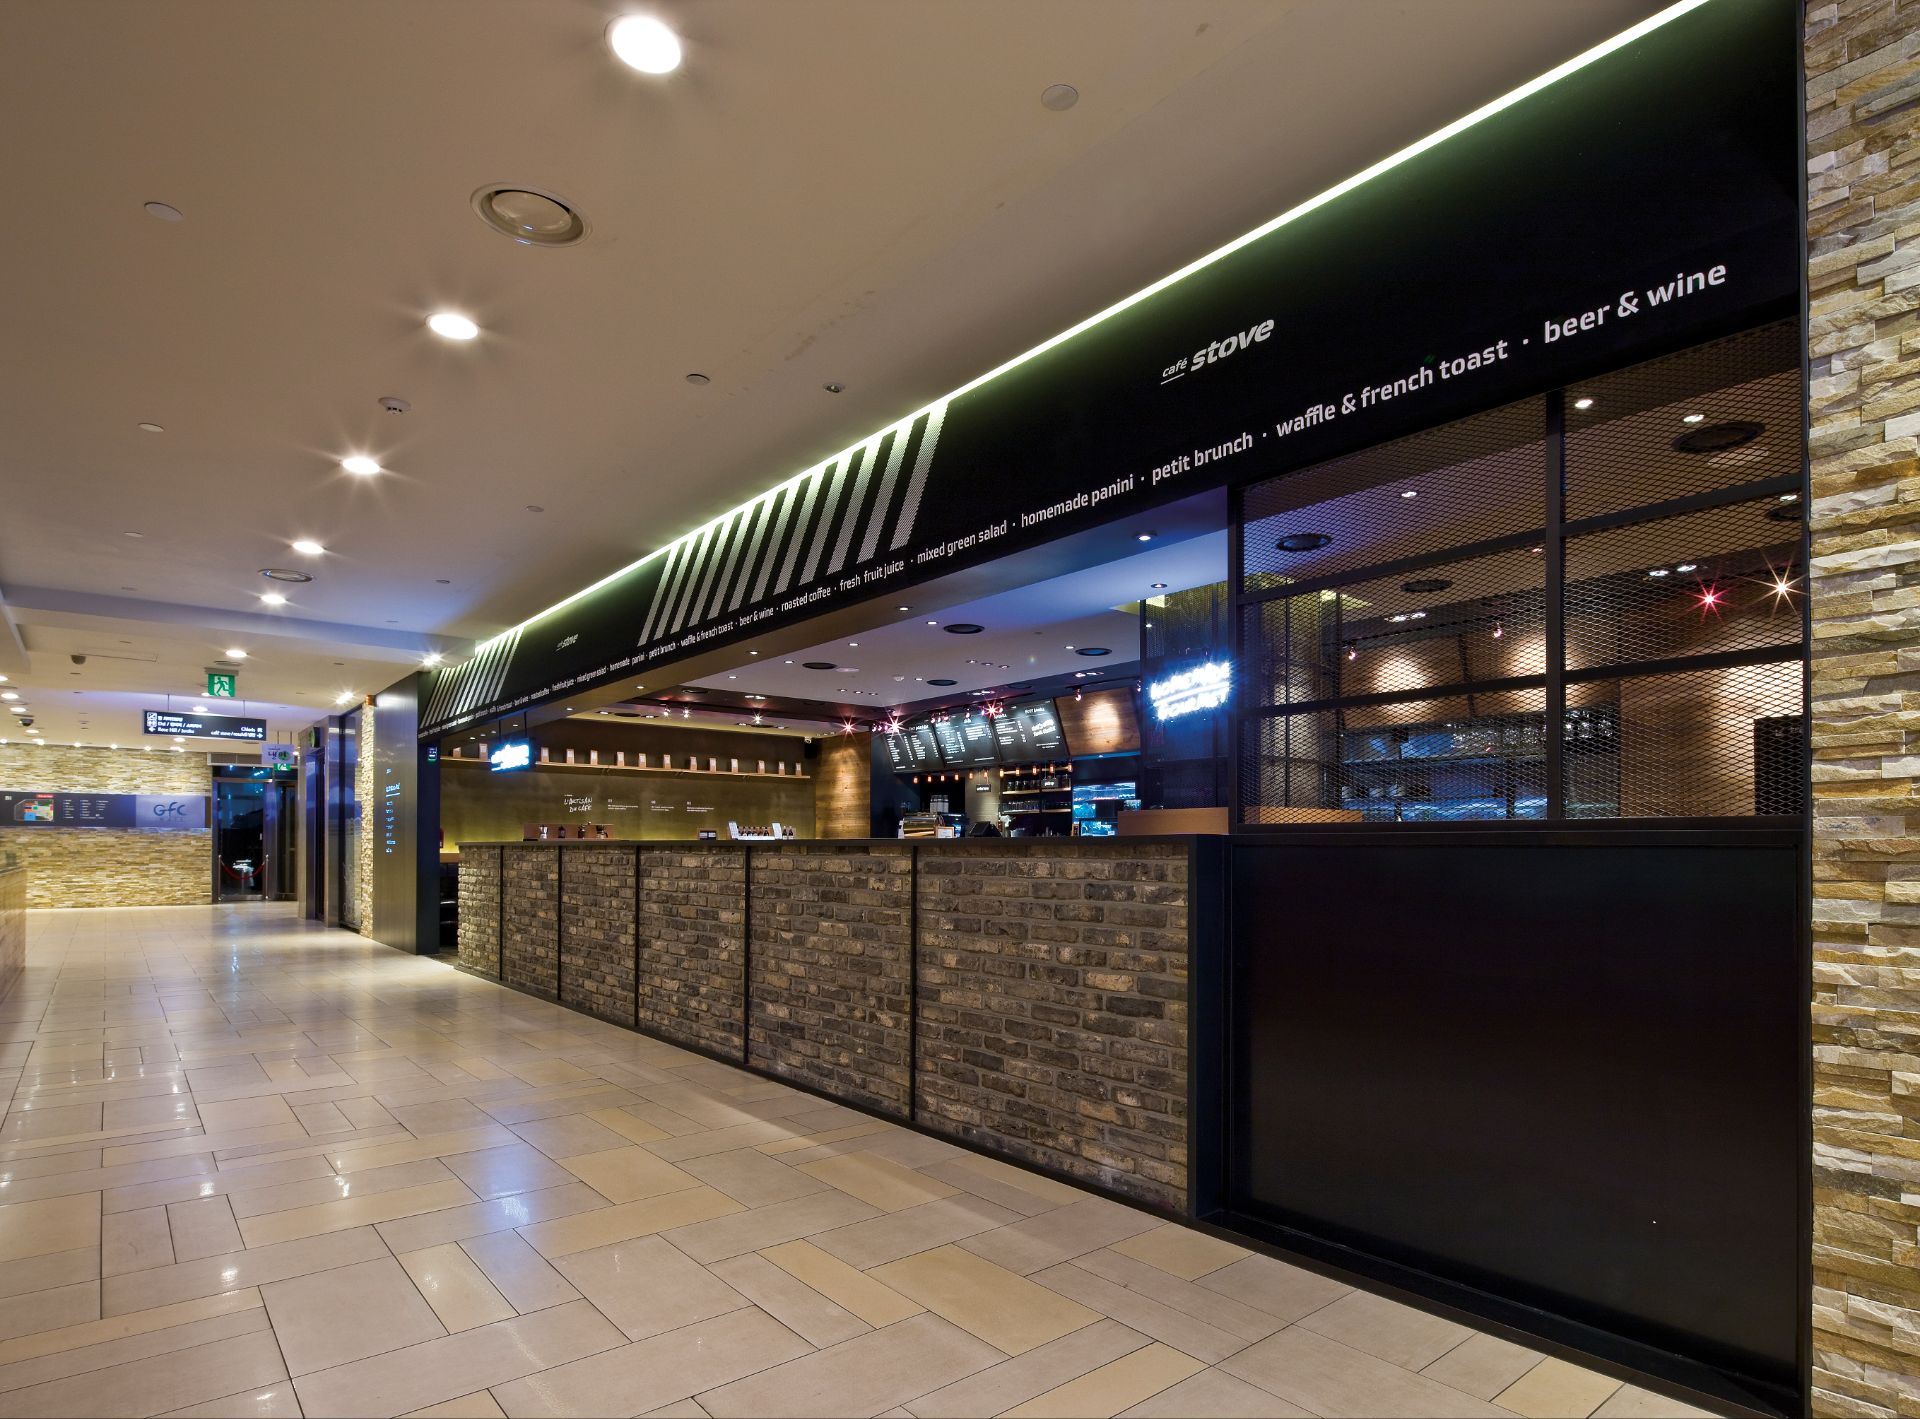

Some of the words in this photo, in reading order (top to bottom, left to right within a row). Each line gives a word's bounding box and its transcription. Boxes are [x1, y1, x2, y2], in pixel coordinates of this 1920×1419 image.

[718, 622, 733, 634] toast
[740, 615, 752, 626] beer
[759, 608, 773, 619] wine
[781, 592, 807, 611] roasted
[809, 587, 830, 602] coffee
[840, 575, 860, 591] fresh
[864, 567, 883, 582] fruit
[882, 561, 904, 578] juice
[918, 542, 944, 563] mixed
[948, 535, 975, 556] green
[979, 520, 1006, 542] salad
[1022, 493, 1088, 527] homemade
[1092, 474, 1133, 506] panini
[1153, 456, 1190, 485] petit
[1195, 432, 1252, 466] brunch
[1276, 404, 1335, 436] waffle
[1342, 394, 1356, 414] &
[1361, 367, 1432, 407] french
[1440, 340, 1507, 378] toast
[1545, 306, 1610, 343] beer
[1618, 291, 1639, 317] &
[1647, 265, 1725, 306] wine
[1163, 358, 1187, 377] café
[1191, 320, 1274, 371] stove
